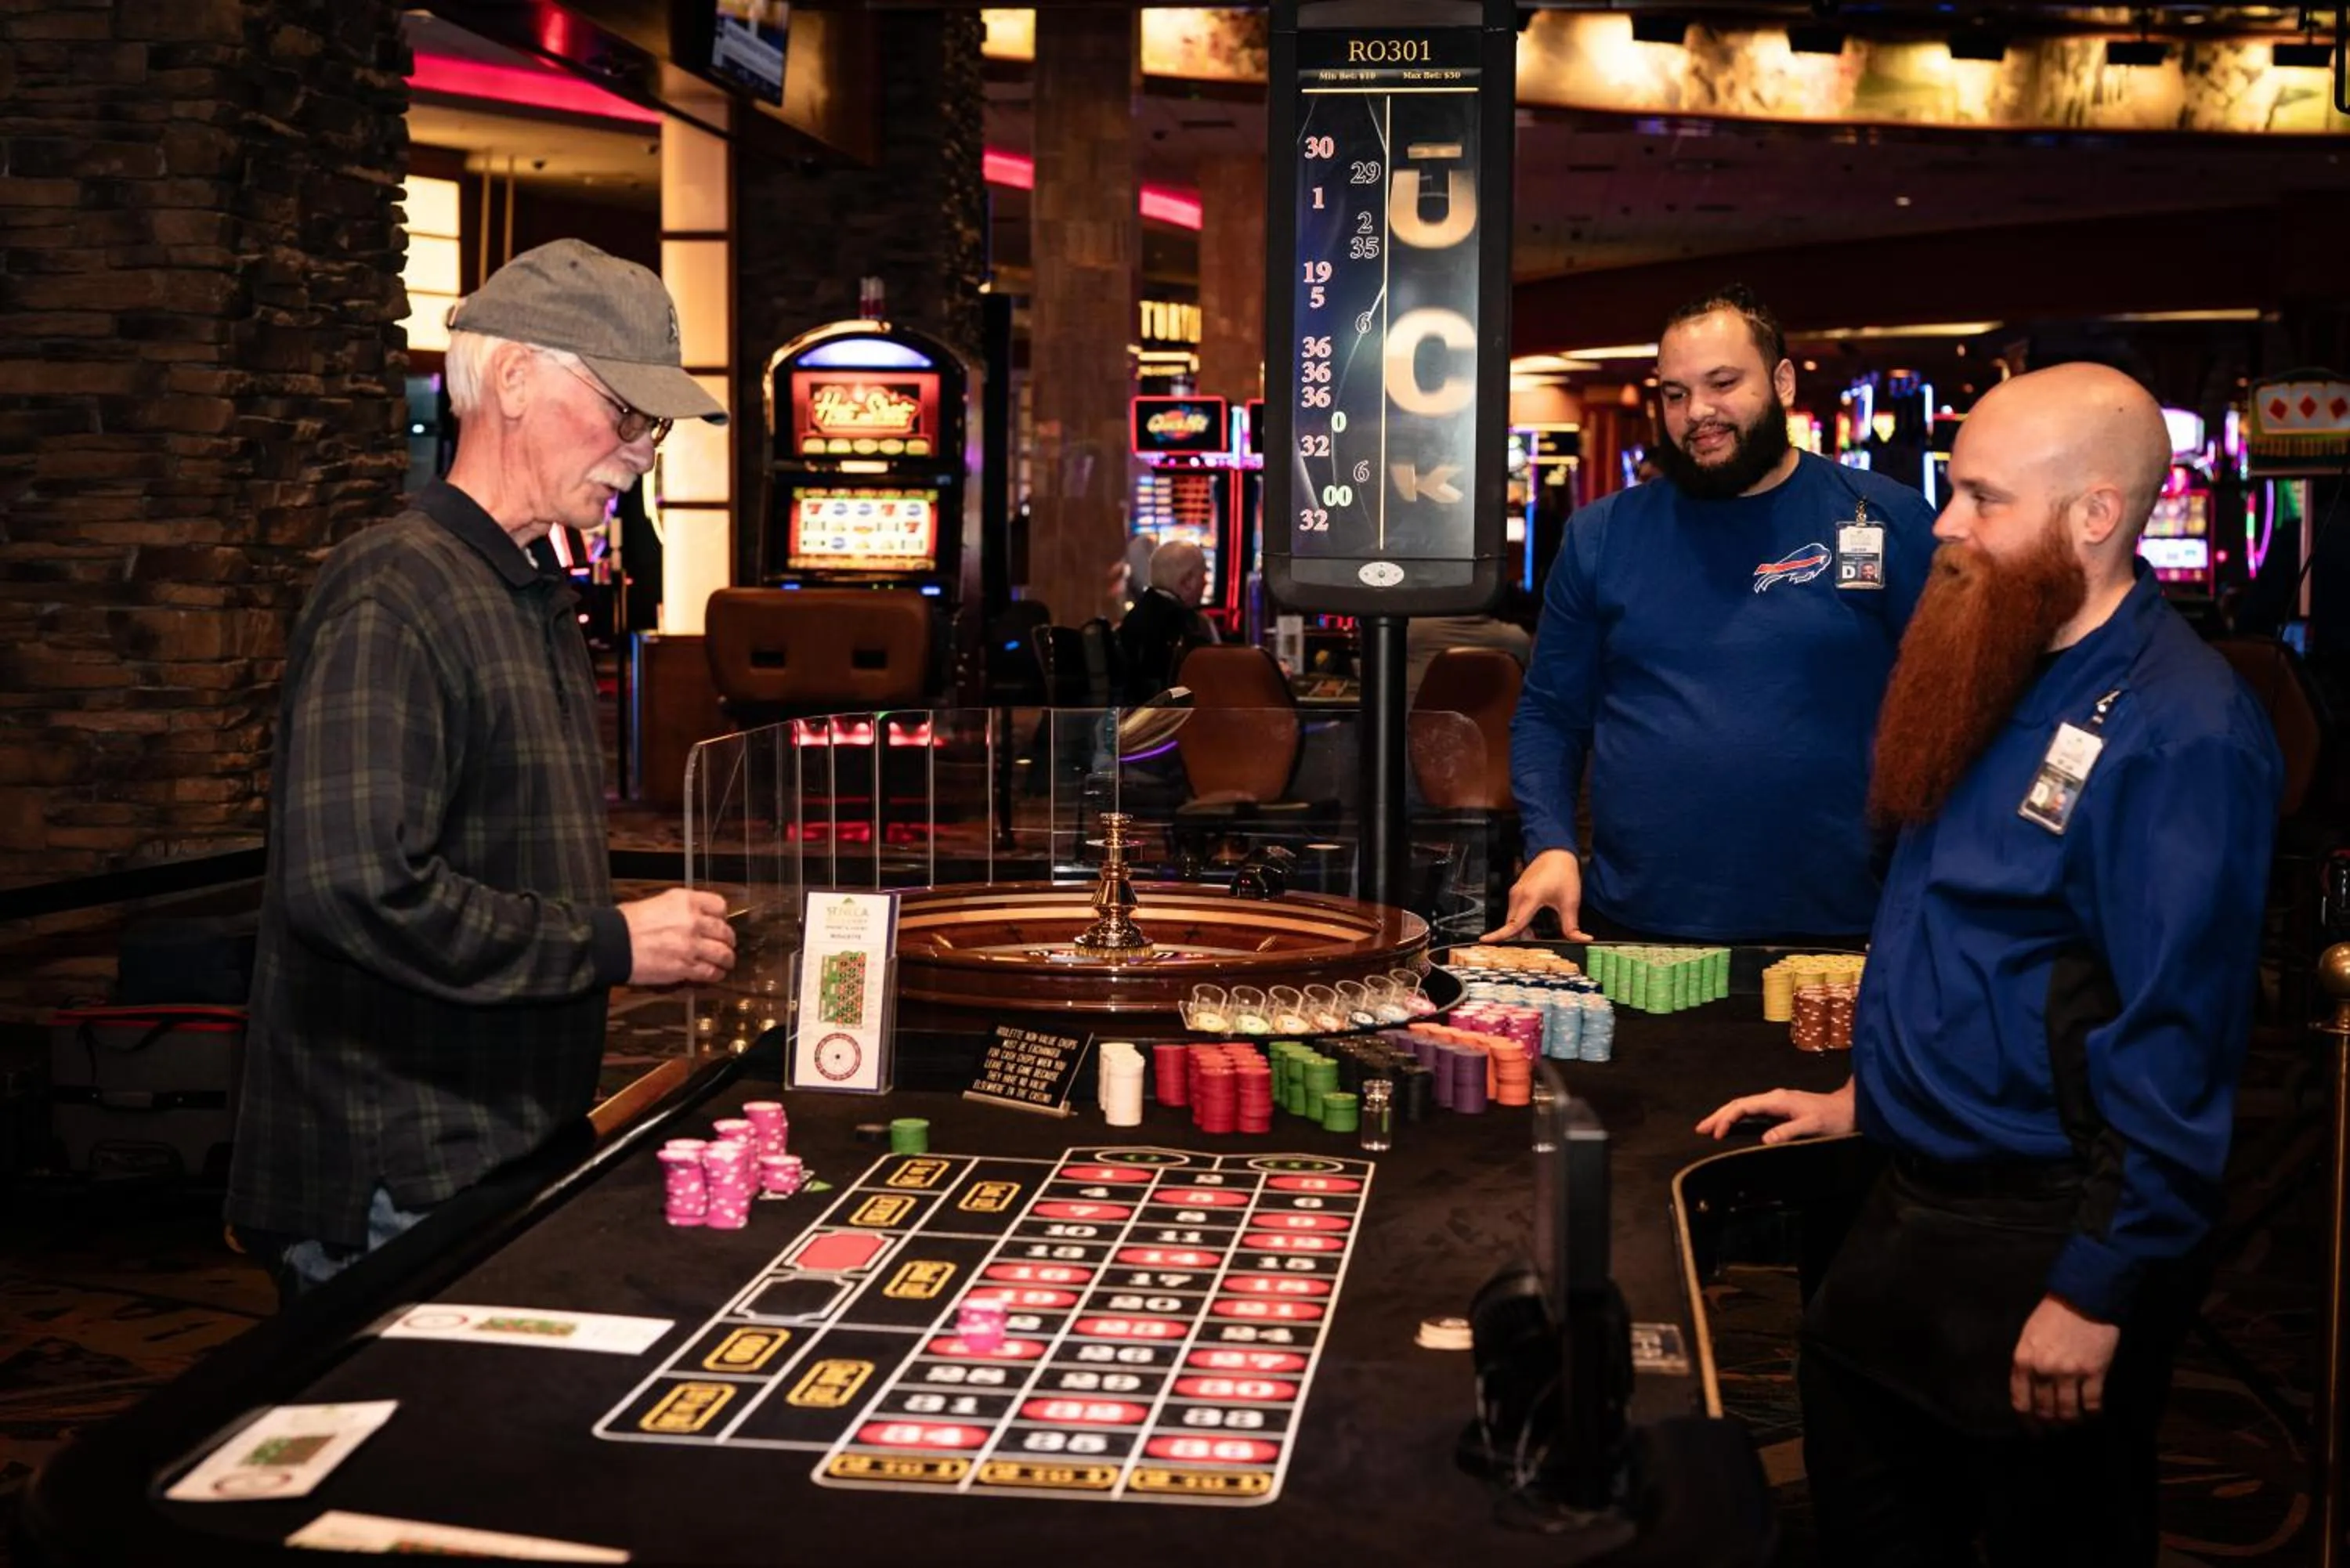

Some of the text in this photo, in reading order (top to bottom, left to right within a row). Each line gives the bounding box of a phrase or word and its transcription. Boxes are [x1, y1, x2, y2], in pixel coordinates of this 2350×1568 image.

[1348, 40, 1432, 62] RO301
[1319, 71, 1337, 80] Min
[1403, 70, 1421, 79] Max
[1304, 136, 1334, 159] 30
[1350, 161, 1381, 184] 29
[1312, 187, 1325, 209] 1
[1357, 211, 1373, 234] 2
[1350, 237, 1379, 259] 35
[1303, 261, 1332, 283] 19
[1309, 286, 1325, 309] 5
[1355, 312, 1372, 334] 6
[1301, 336, 1332, 358] 36
[1301, 361, 1332, 383] 36
[1301, 386, 1332, 408] 36
[1331, 411, 1347, 433] 0
[1300, 435, 1330, 457] 32
[1353, 460, 1370, 482] 6
[1323, 485, 1353, 507] 00
[1299, 509, 1329, 531] 32
[1842, 565, 1856, 579] D
